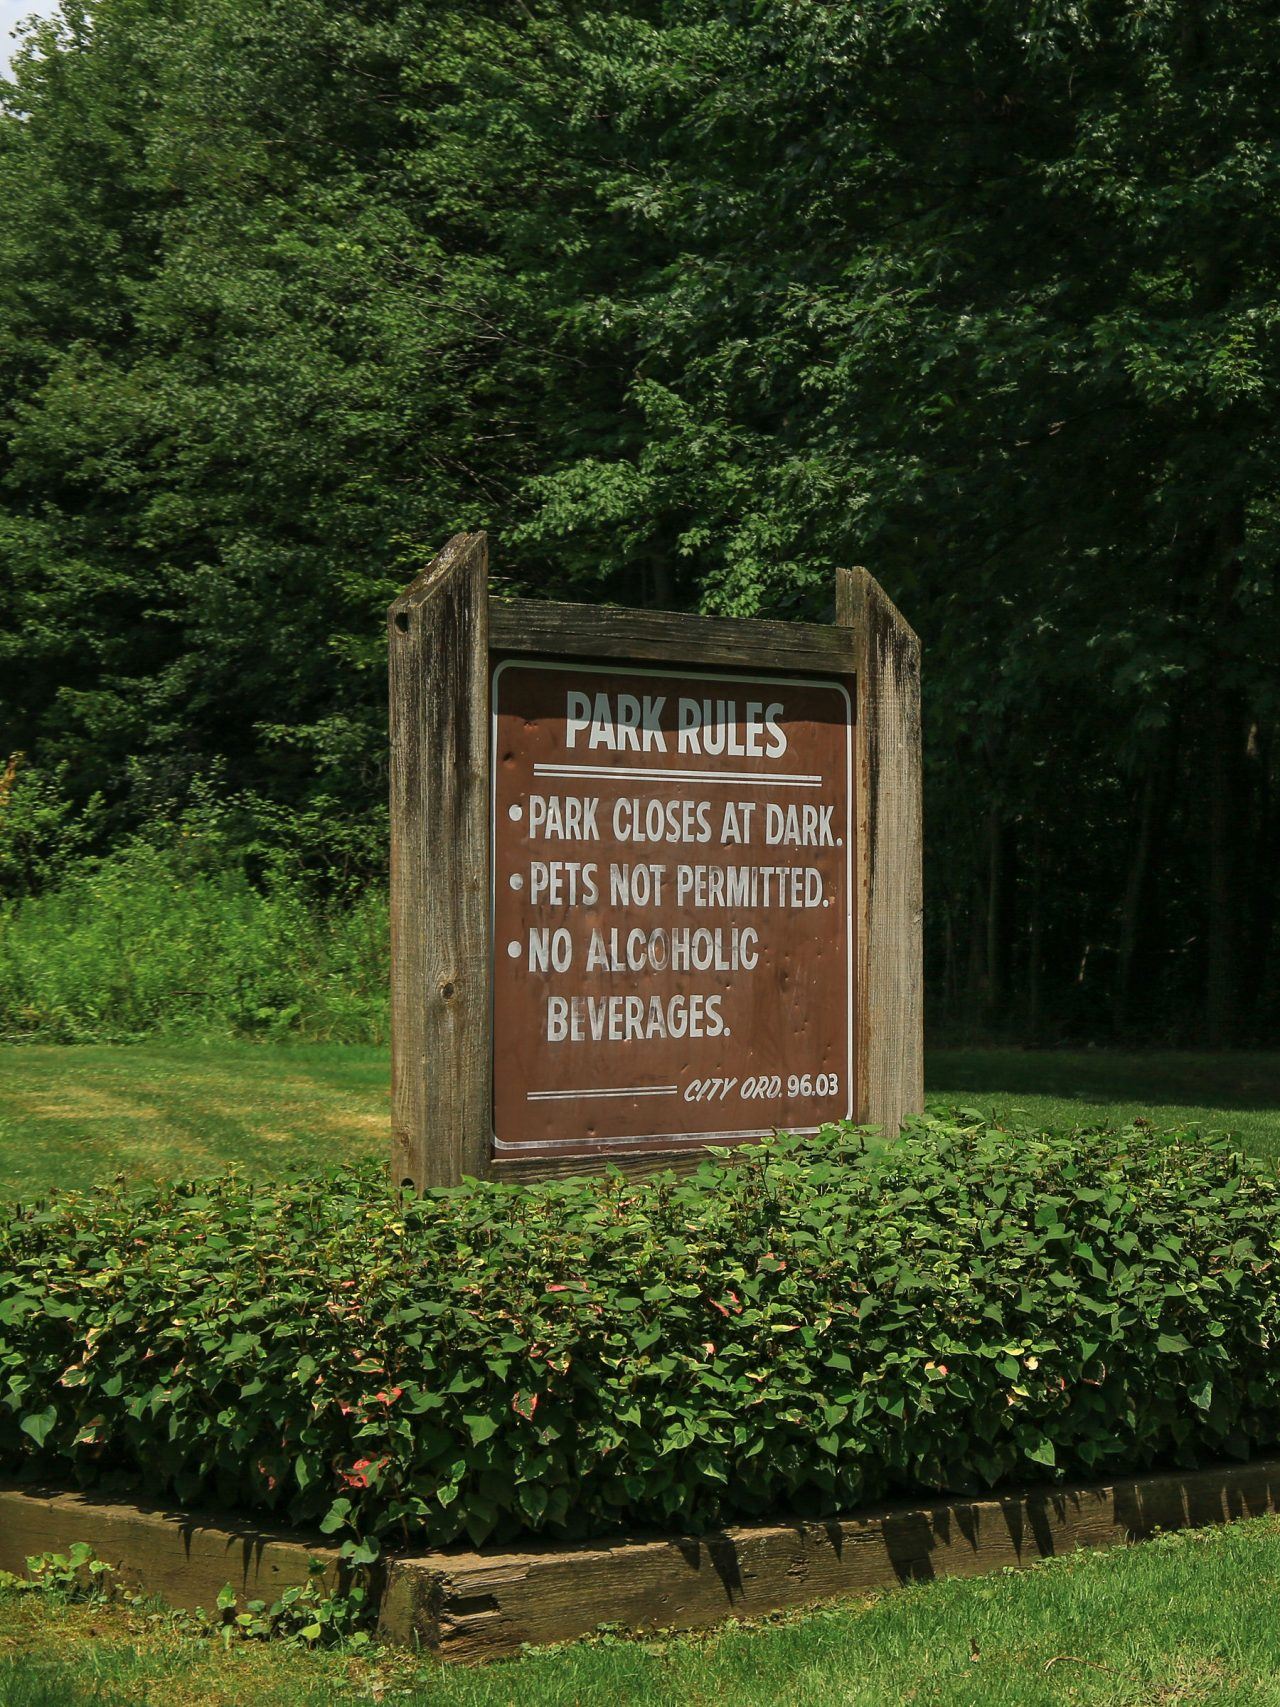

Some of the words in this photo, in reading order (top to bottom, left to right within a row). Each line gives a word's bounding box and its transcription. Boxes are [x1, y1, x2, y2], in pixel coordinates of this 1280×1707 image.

[566, 691, 668, 752] PARK
[678, 698, 788, 759] RULES
[529, 795, 600, 840] PARK
[612, 797, 712, 843] CLOSES
[720, 802, 756, 844] AT
[765, 803, 843, 847] DARK.
[530, 861, 598, 906] PETS
[610, 863, 667, 907] NOT
[677, 865, 829, 908] PERMITTED.
[528, 927, 573, 973] NO
[586, 927, 759, 972] ALCOHOLIC
[547, 994, 731, 1042] BEVERAGES.
[684, 1077, 738, 1102] CITY
[740, 1076, 783, 1100] ORD.
[787, 1073, 839, 1098] 96.03
